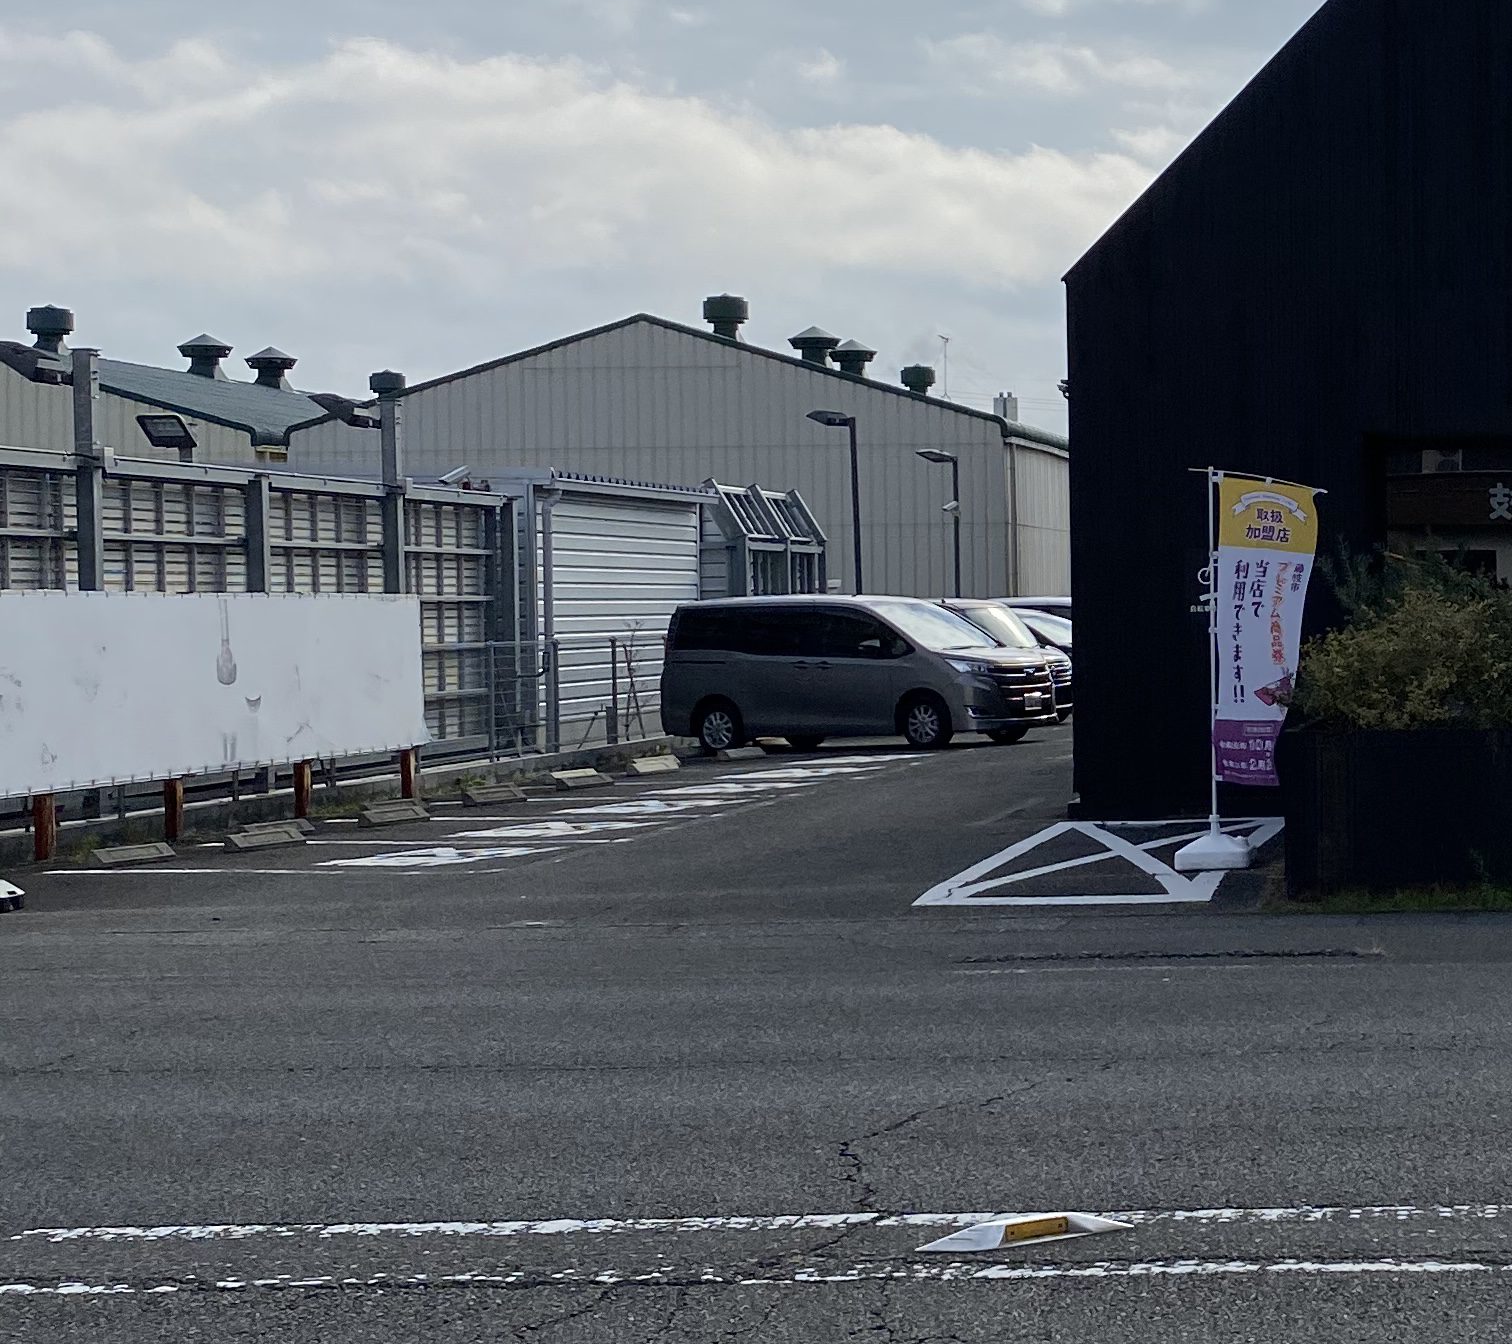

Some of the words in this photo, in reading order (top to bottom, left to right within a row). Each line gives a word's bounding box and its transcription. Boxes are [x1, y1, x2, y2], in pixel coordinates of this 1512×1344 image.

[1256, 507, 1284, 524] 取扱
[1245, 524, 1291, 543] 加盟店
[1249, 559, 1270, 618] 当店で
